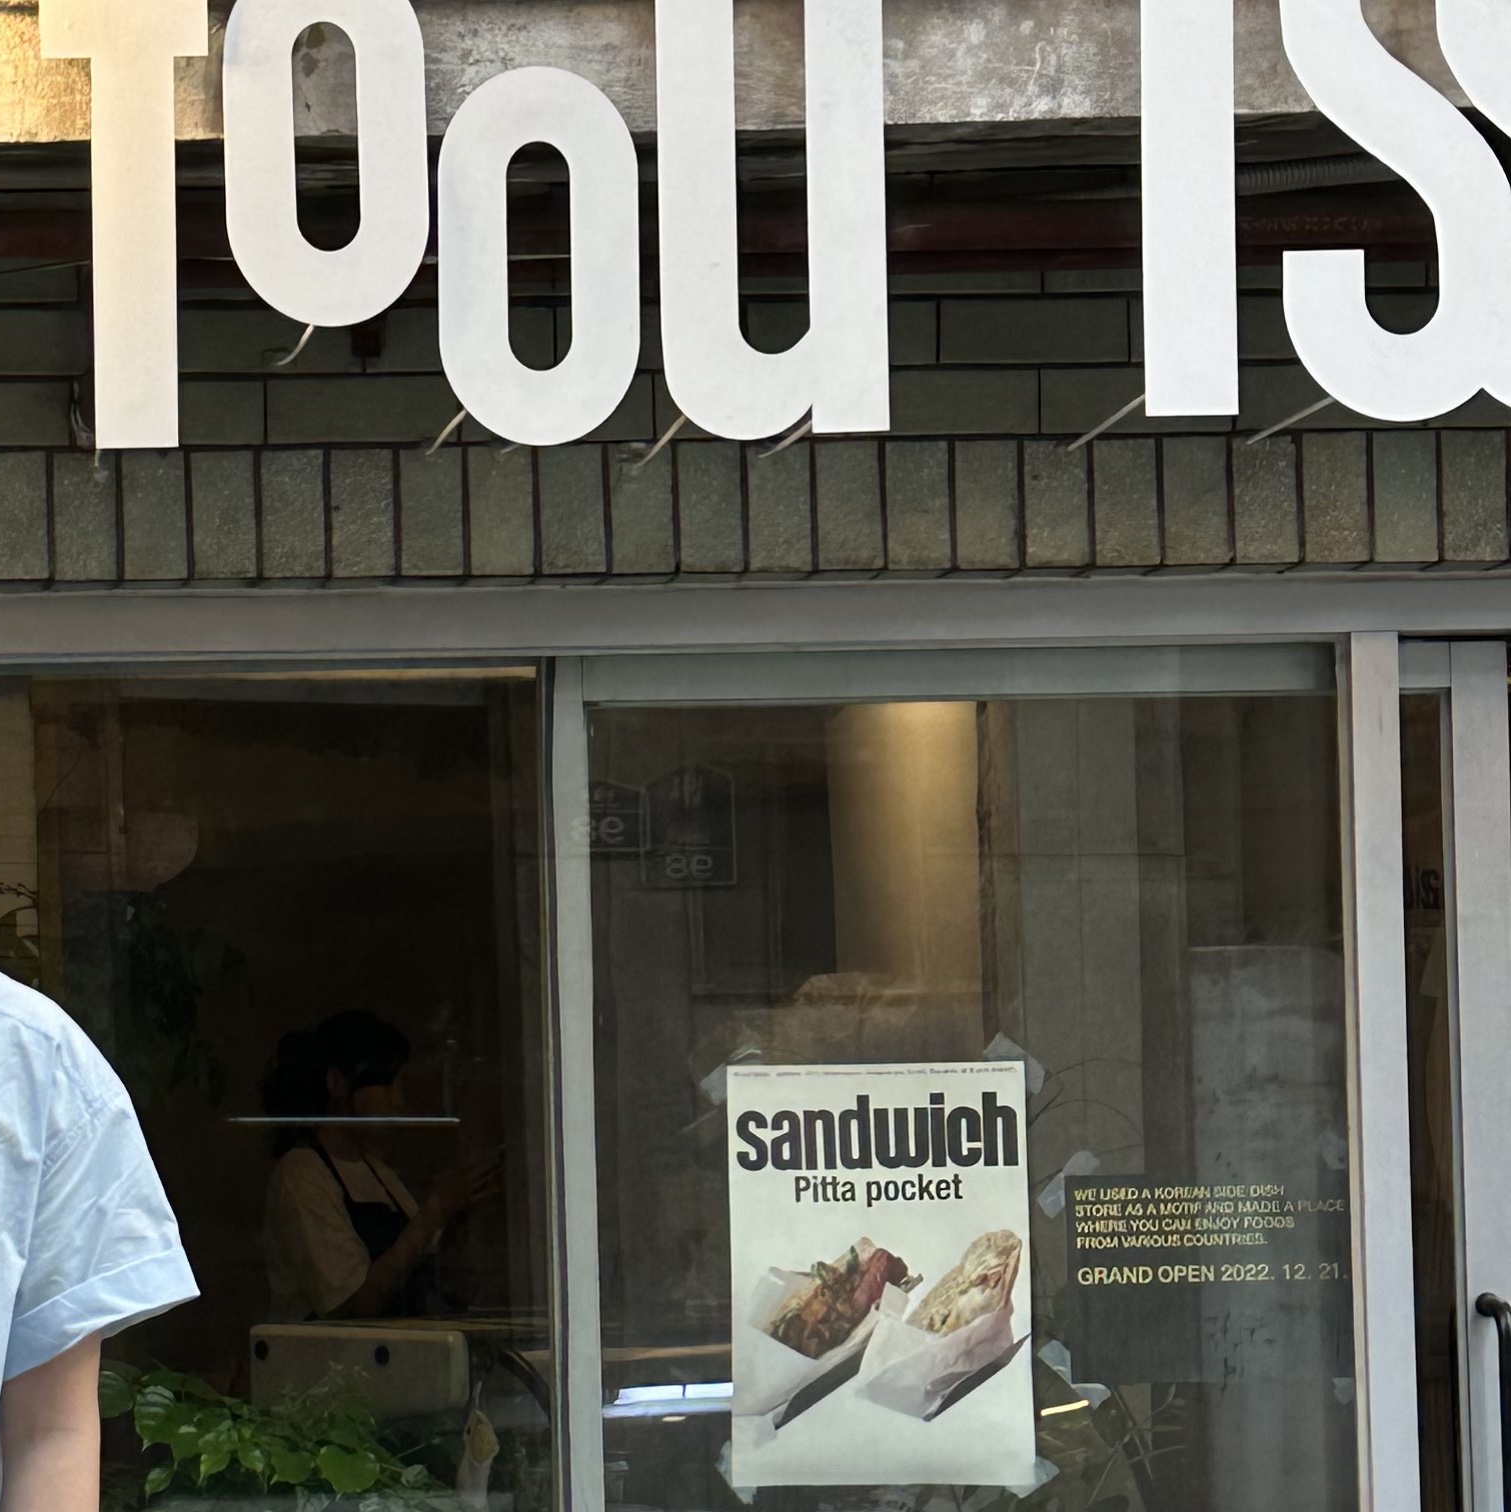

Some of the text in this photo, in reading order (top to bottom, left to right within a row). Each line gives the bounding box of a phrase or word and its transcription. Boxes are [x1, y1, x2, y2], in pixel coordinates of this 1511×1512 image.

[736, 1091, 1019, 1171] sandwich
[794, 1173, 963, 1207] Pitta pocket
[1074, 1188, 1096, 1201] WE
[1142, 1187, 1152, 1199] A
[1154, 1186, 1210, 1200] KOREAN
[1075, 1203, 1122, 1217] STORE
[1125, 1202, 1143, 1216] AS
[1146, 1202, 1157, 1215] A
[1205, 1201, 1234, 1214] AND
[1238, 1200, 1281, 1213] MADE
[1284, 1200, 1295, 1212] A
[1297, 1199, 1345, 1212] PLACE
[1076, 1215, 1295, 1233] WHERE YOU CAN ENJOY FOODS
[1076, 1235, 1119, 1249] FROM
[1121, 1234, 1181, 1248] VARIOUS
[1077, 1262, 1348, 1285] GRAND OPEN 2022. 12. 21.
